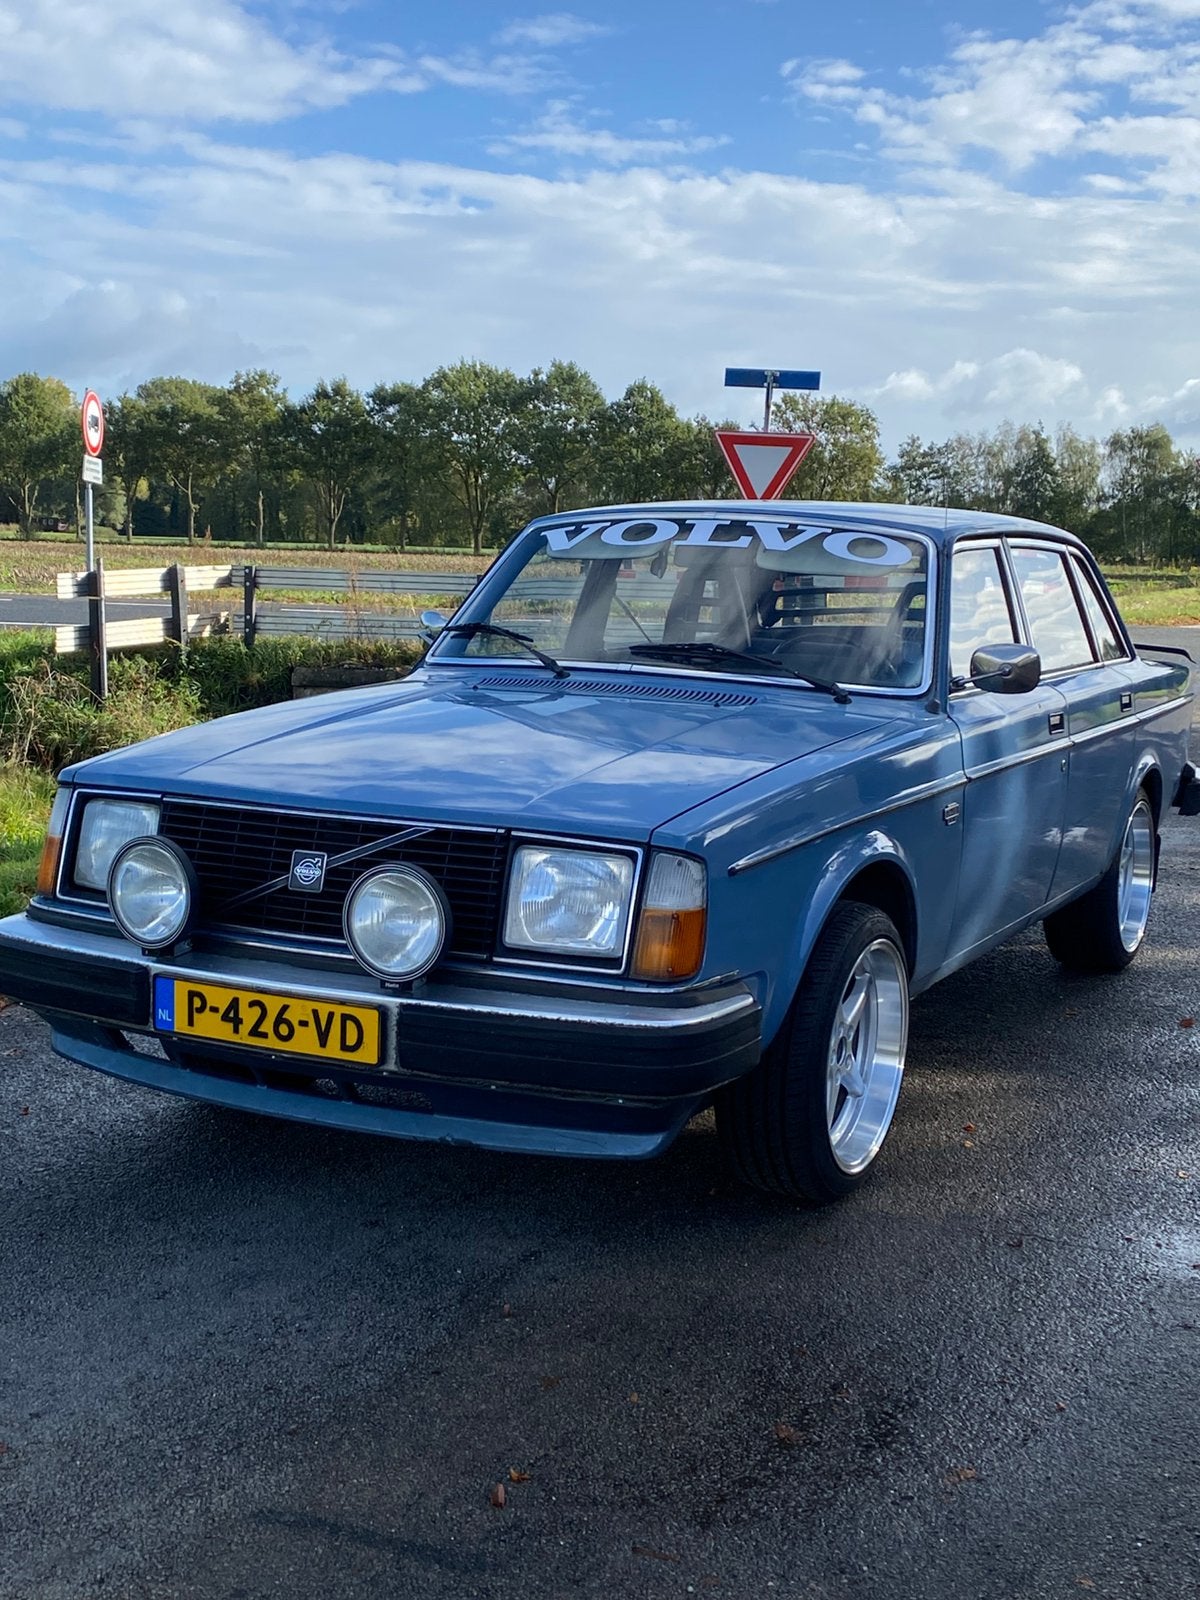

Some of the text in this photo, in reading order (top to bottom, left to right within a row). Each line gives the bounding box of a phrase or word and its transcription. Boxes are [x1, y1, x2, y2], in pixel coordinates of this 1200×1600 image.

[541, 519, 912, 566] VOLVO
[295, 867, 320, 875] VOLVO
[158, 1008, 172, 1021] NL
[187, 990, 364, 1053] P-426-VD
